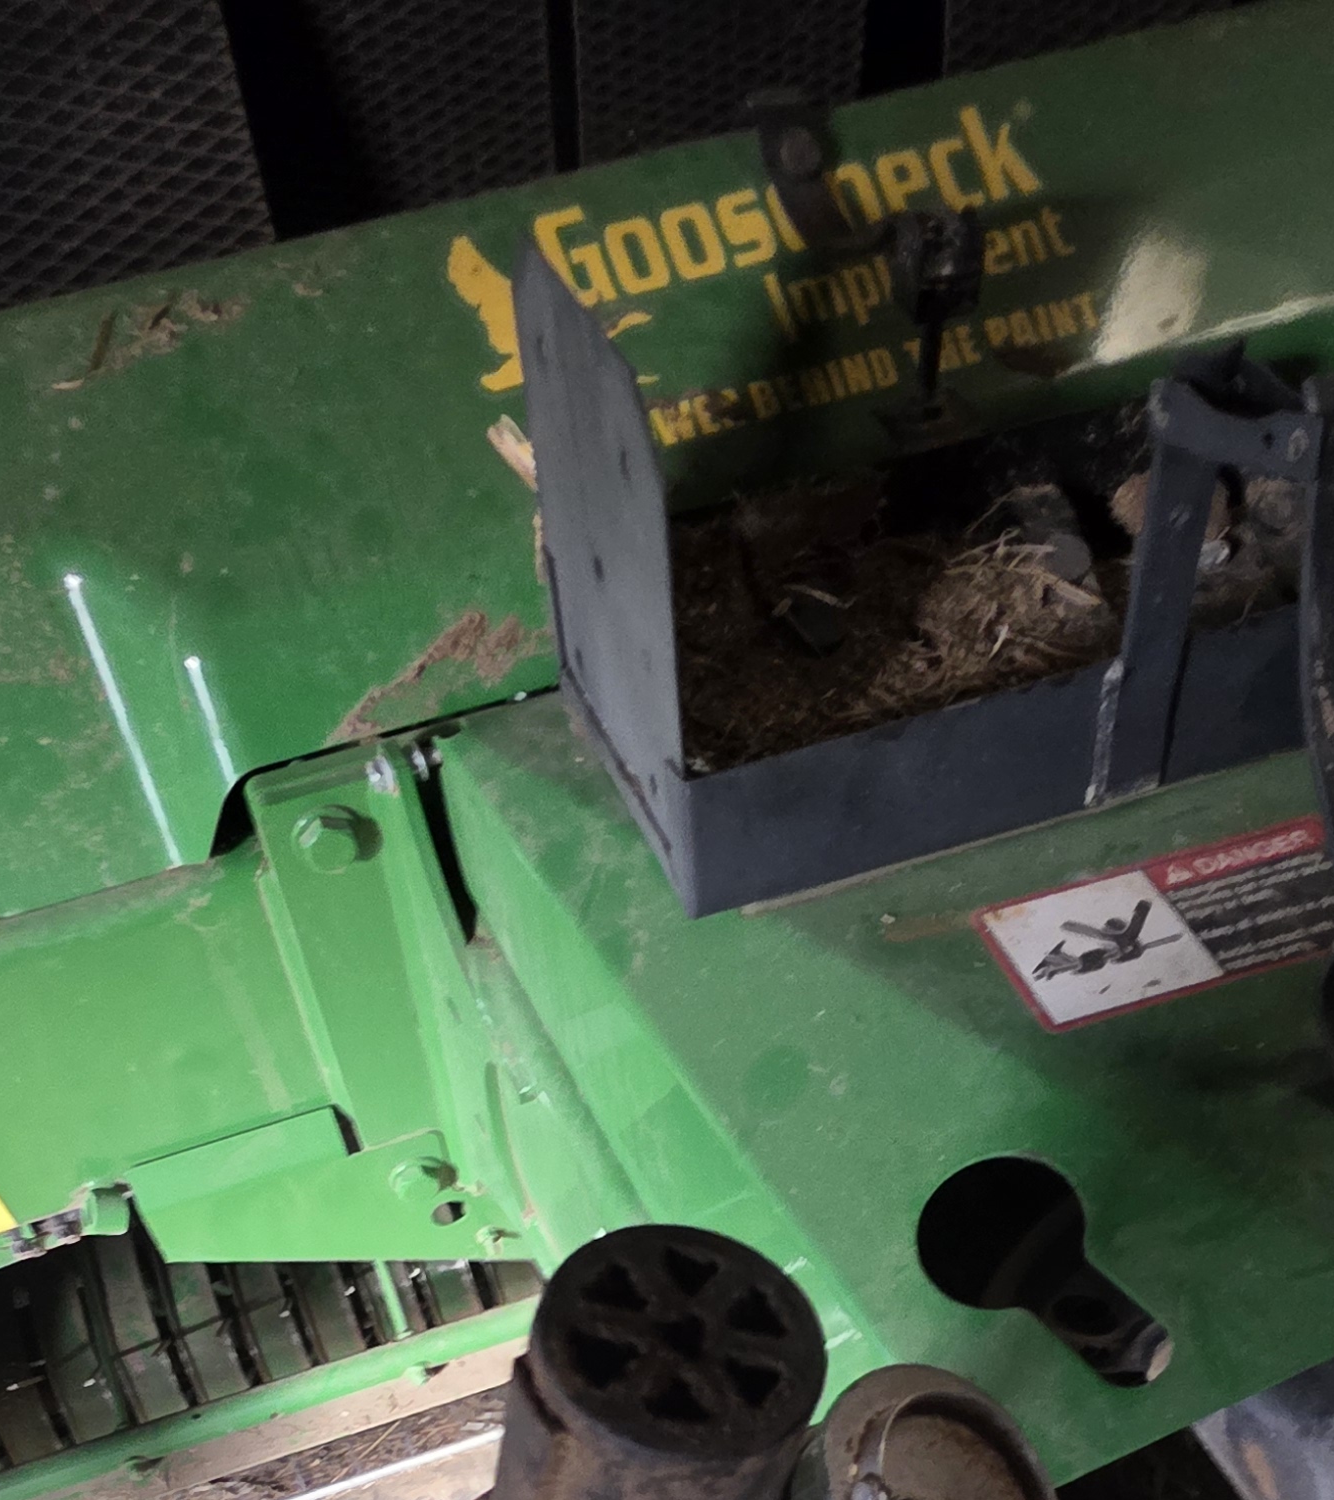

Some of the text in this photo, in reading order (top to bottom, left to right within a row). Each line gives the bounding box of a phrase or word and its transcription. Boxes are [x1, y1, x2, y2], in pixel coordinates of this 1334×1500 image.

[763, 206, 1075, 338] Implent
[983, 291, 1100, 349] PAINT
[1192, 828, 1312, 877] DANGER
